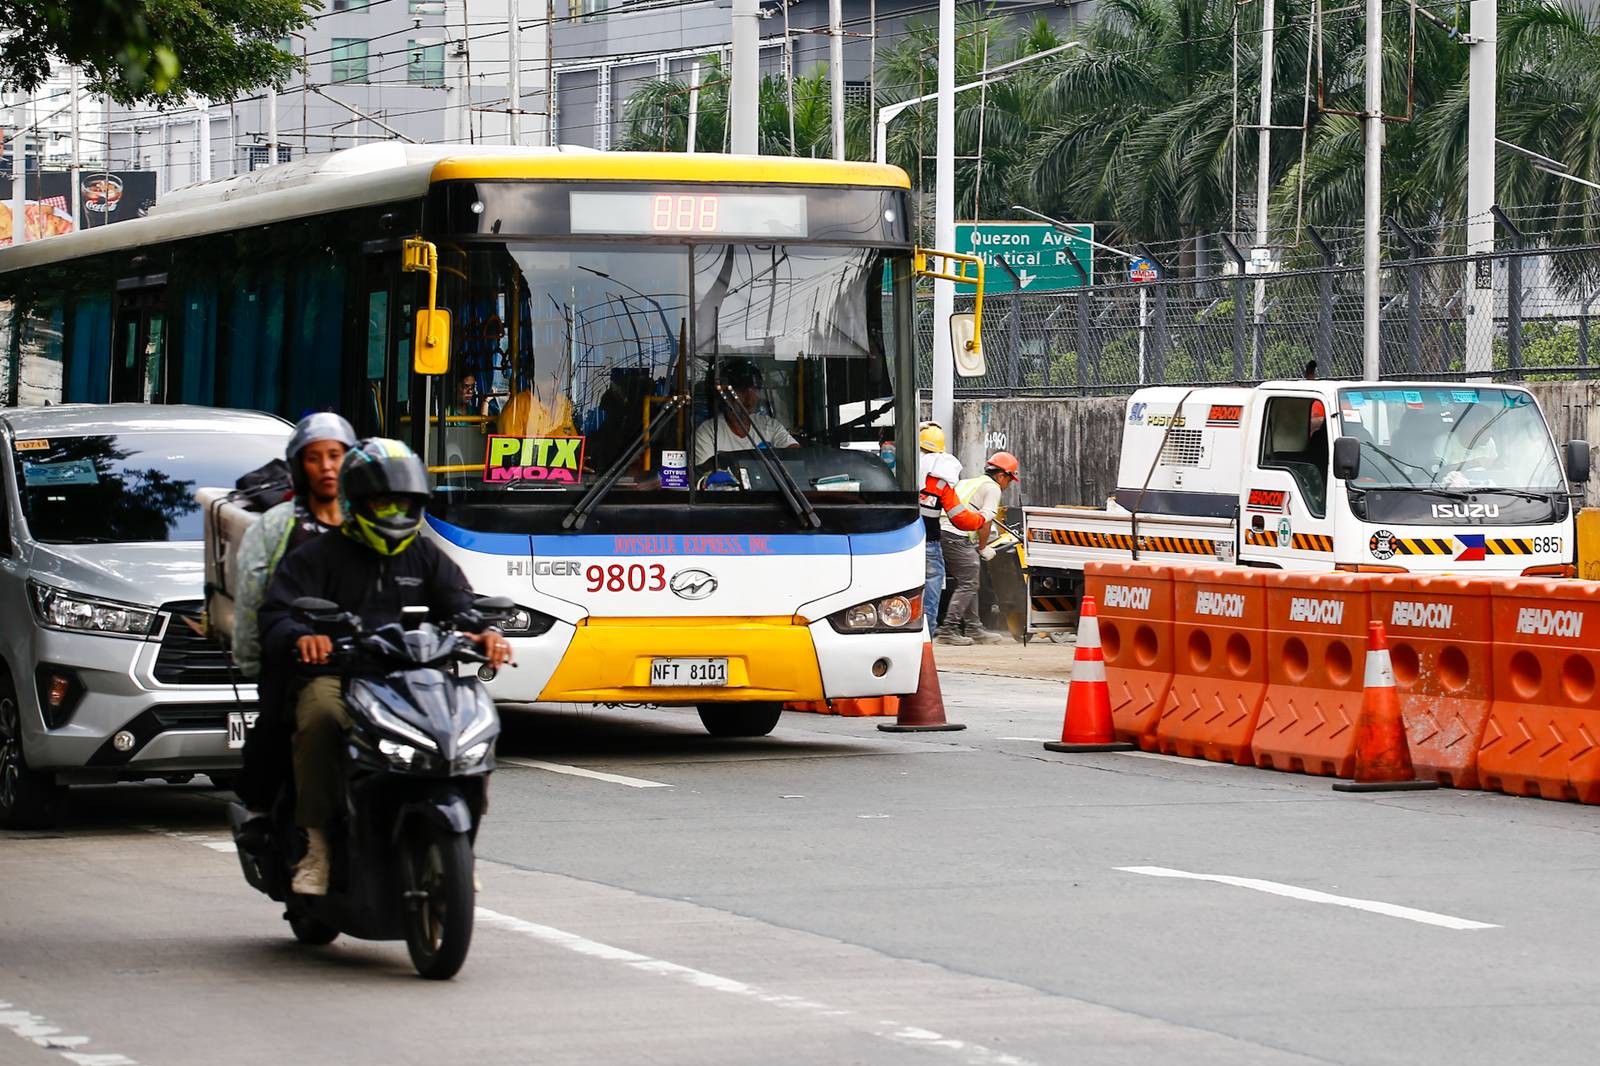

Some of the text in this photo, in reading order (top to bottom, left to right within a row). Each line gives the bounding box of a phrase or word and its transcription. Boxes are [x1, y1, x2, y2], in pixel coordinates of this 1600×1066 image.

[970, 231, 1076, 245] Quezon Ave.
[490, 437, 581, 471] PITX
[491, 466, 575, 481] MOA
[1431, 503, 1499, 518] ISUZU
[614, 535, 675, 553] JOYSELLE
[507, 560, 582, 576] HIGER
[586, 563, 667, 593] 9803
[1103, 584, 1152, 610] READYCON
[1195, 591, 1246, 618] READYCON
[1289, 597, 1345, 625] READYCON
[1391, 601, 1453, 629] READYCON
[1516, 607, 1584, 638] READYCON
[653, 664, 726, 680] NFT 8101
